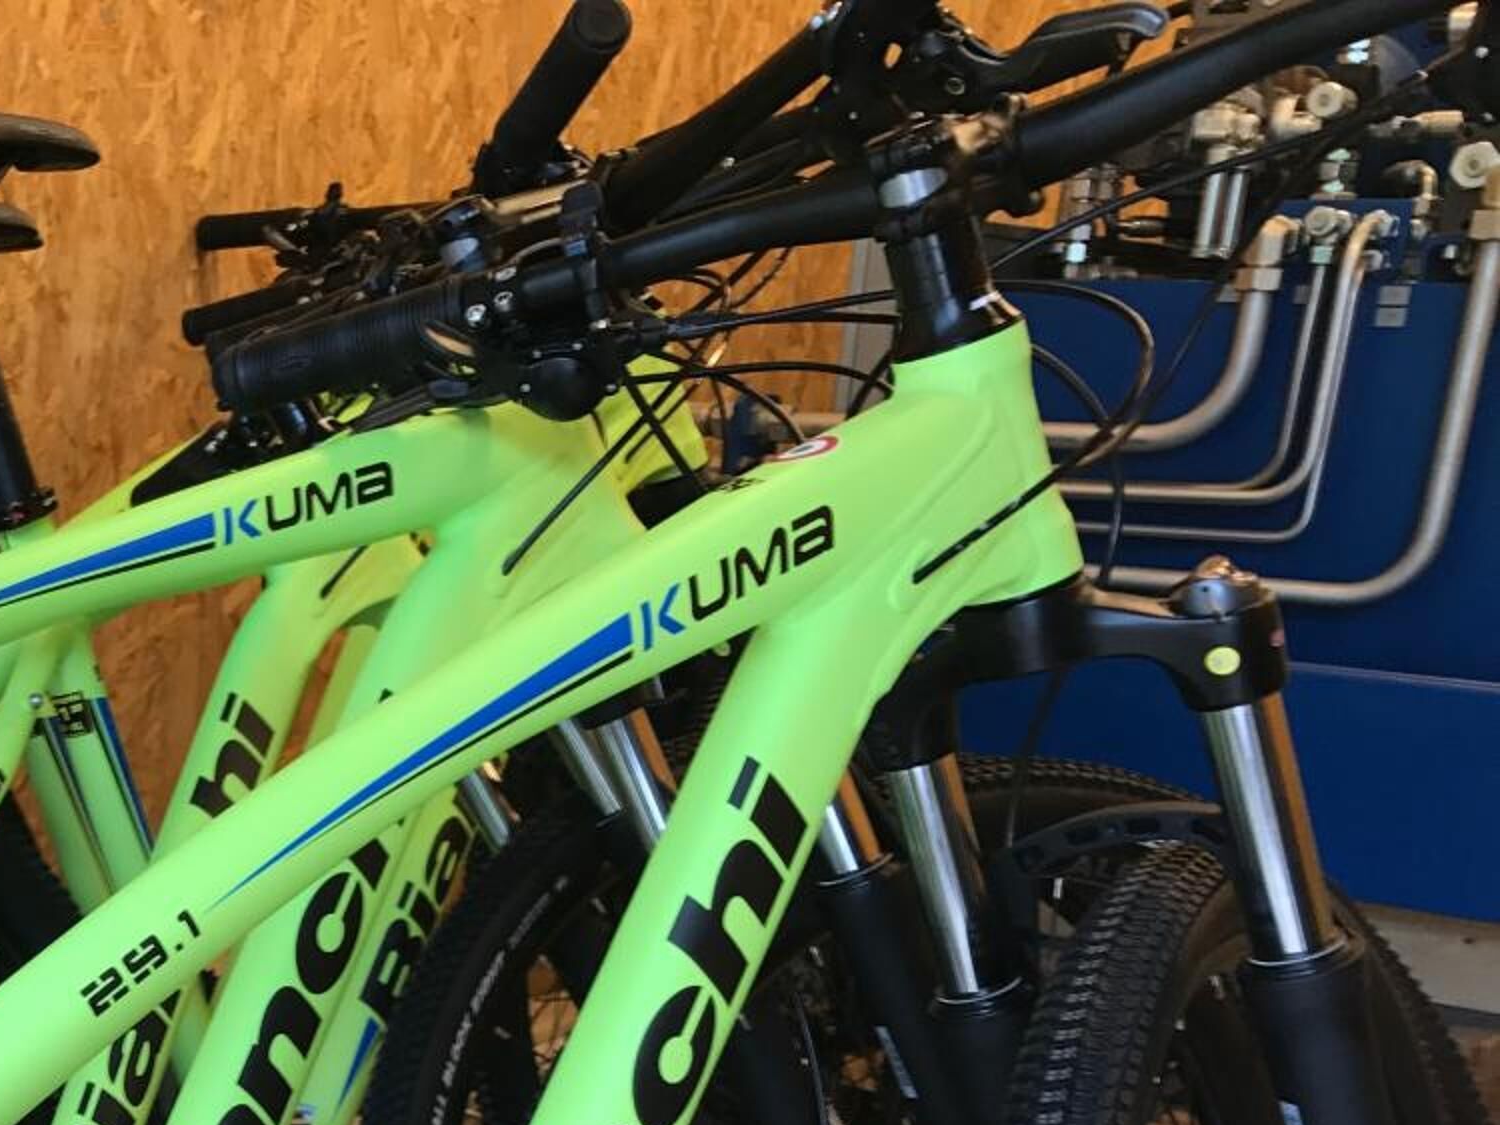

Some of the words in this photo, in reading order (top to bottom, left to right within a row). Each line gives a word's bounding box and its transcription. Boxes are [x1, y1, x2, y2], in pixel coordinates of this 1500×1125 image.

[223, 461, 394, 545] KUMA
[642, 504, 835, 651] KUMA
[80, 909, 202, 1017] 29.1
